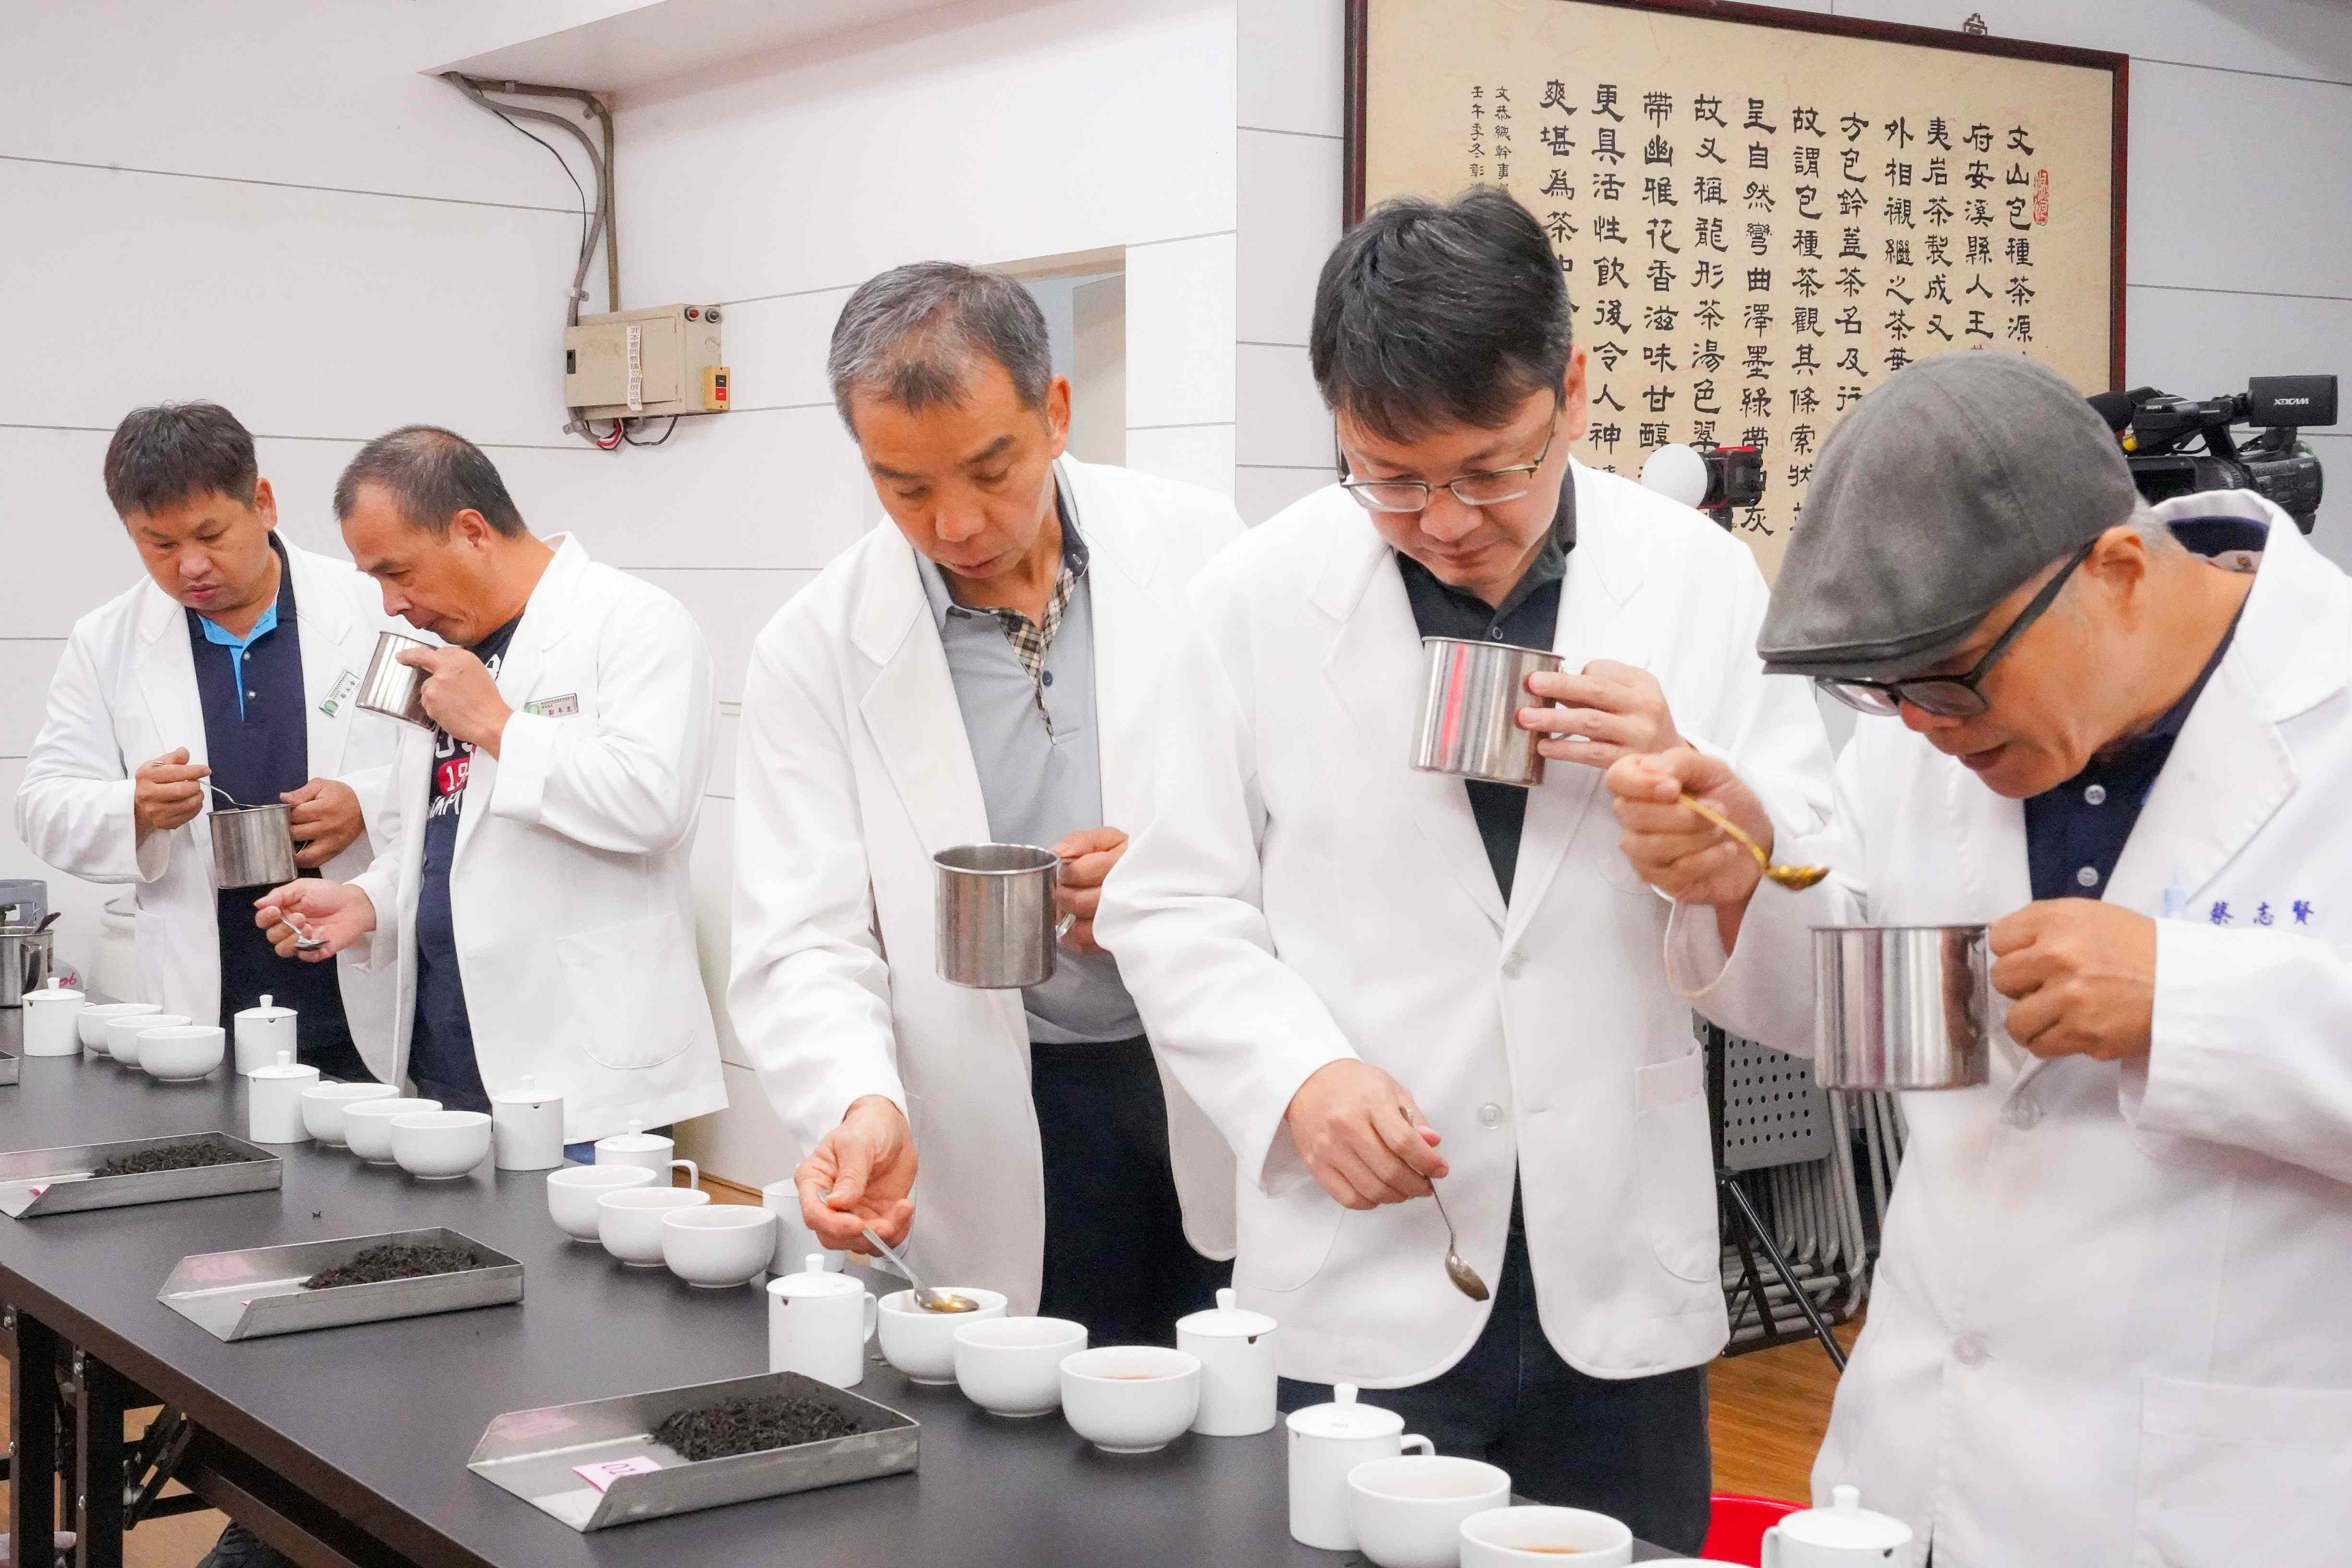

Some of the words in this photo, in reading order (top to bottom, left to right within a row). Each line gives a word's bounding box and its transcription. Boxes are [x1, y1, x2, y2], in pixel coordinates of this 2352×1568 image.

[1468, 86, 1485, 187] 壬午季冬彰
[1963, 122, 1996, 350] 府安溪縣人王
[2004, 124, 2036, 355] 文山包種茶源
[1637, 91, 1680, 478] 帶幽雅花香滋味甘醇
[1739, 97, 1777, 535] 呈自然彎曲澤墨綠帶灰
[1787, 106, 1826, 531] 故謂包種茶觀其條索狀
[446, 762, 469, 791] 19
